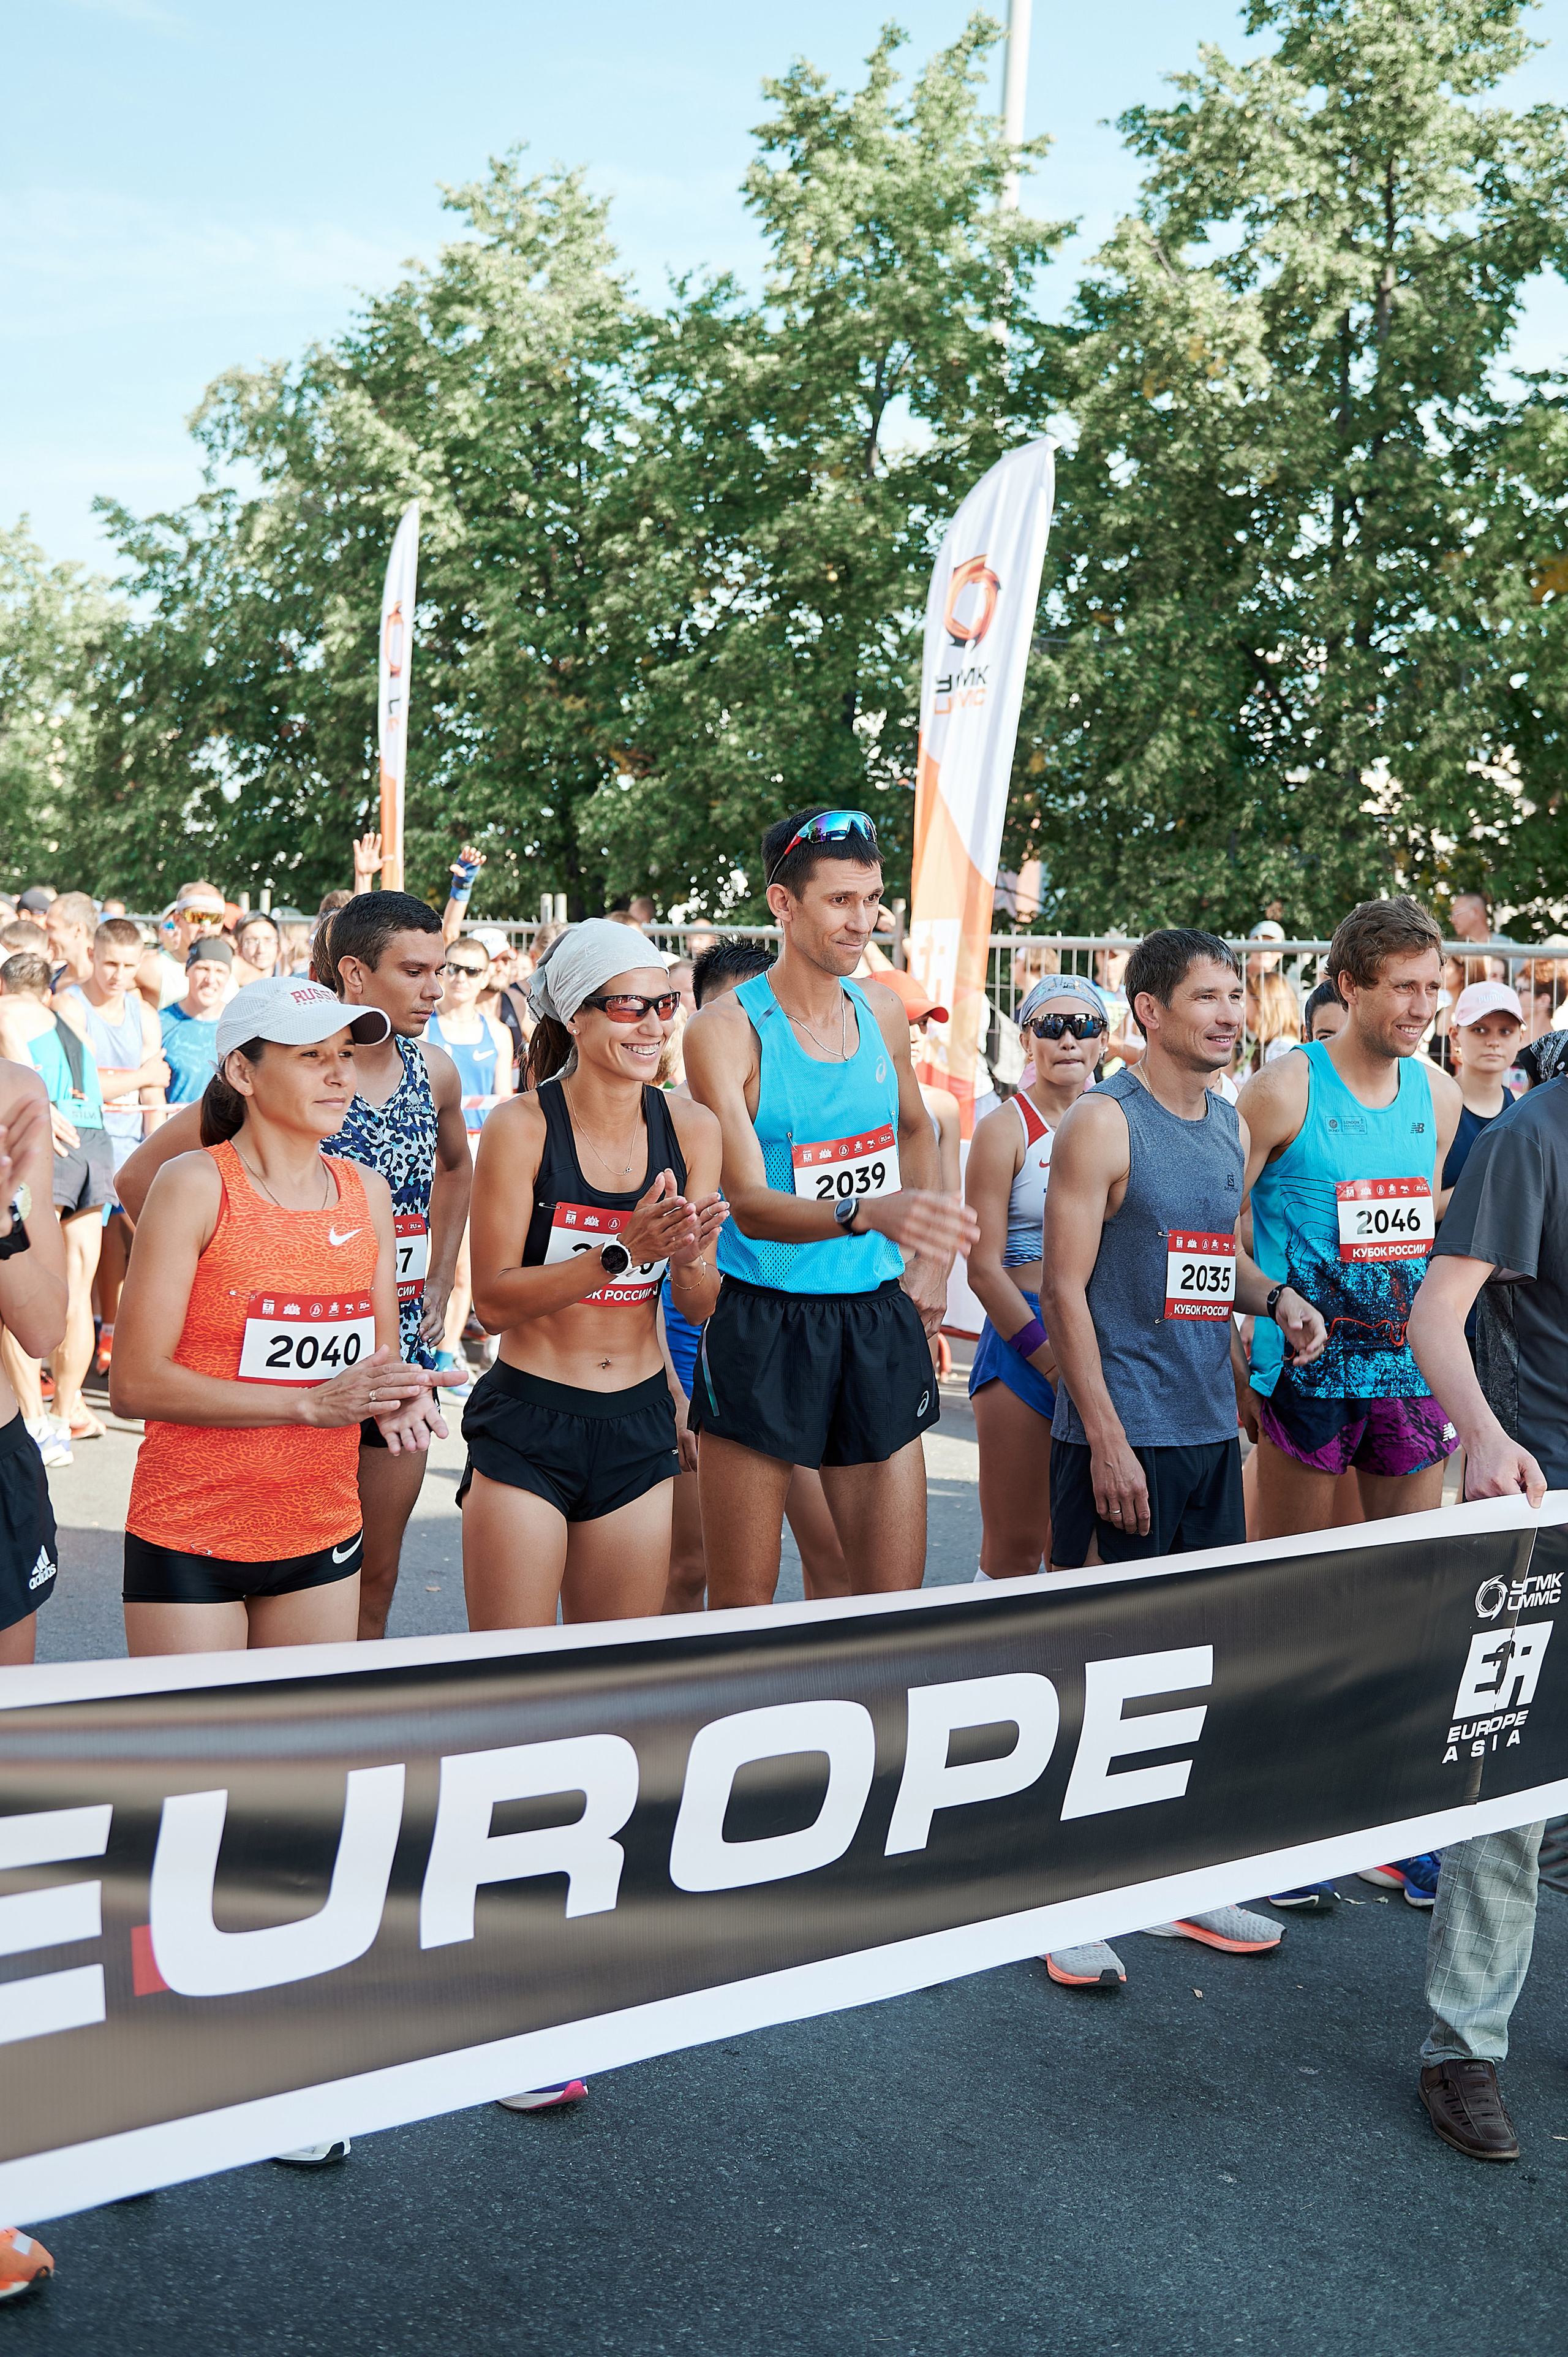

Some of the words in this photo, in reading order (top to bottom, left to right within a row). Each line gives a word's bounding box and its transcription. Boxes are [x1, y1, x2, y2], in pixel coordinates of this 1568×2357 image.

[816, 1162, 885, 1201] 2039
[1356, 1208, 1420, 1235] 2046
[1352, 1246, 1387, 1258] КУБОК
[1388, 1244, 1425, 1255] РОССИИ
[1180, 1264, 1231, 1293] 2035
[604, 1288, 652, 1301] РОССИИ
[1174, 1304, 1202, 1315] КУБОК
[1202, 1306, 1229, 1316] РОССИИ
[265, 1333, 361, 1369] 2040
[29, 1563, 56, 1590] adidas
[1507, 1589, 1561, 1611] UMMC
[1447, 1709, 1529, 1744] EUROPE
[1442, 1729, 1521, 1764] ASIA
